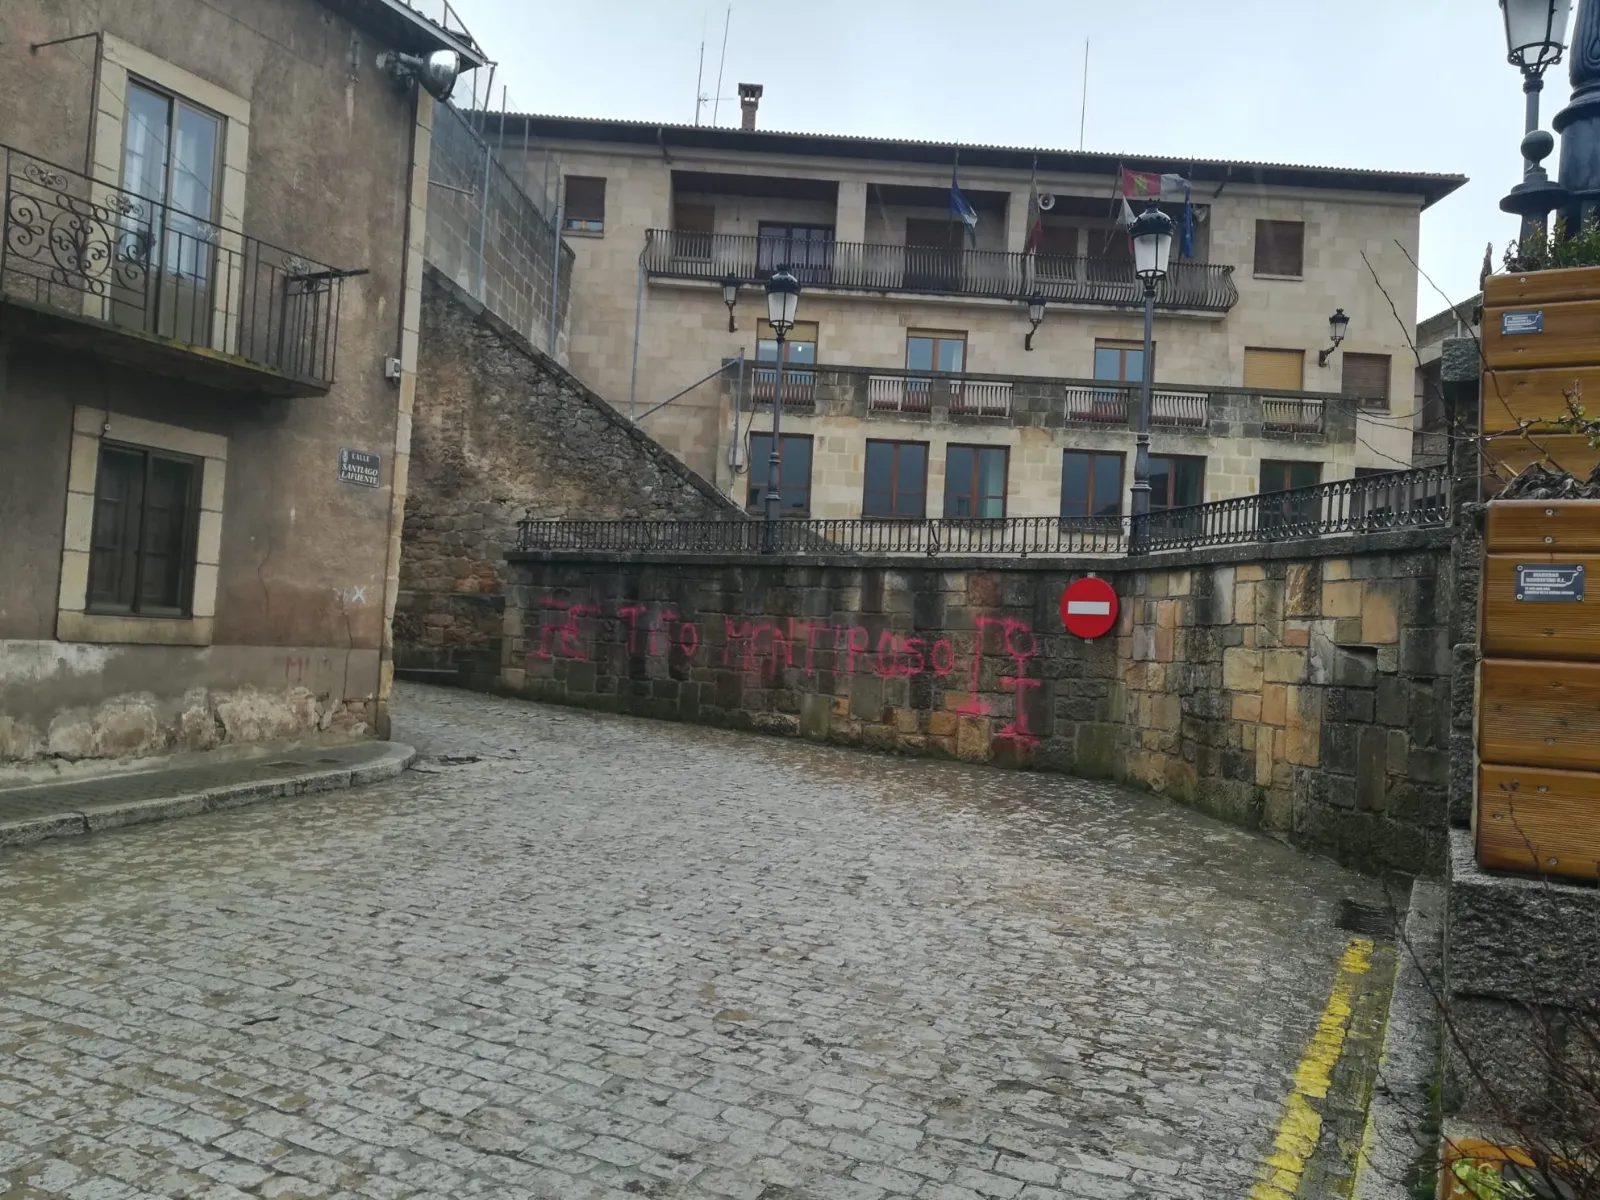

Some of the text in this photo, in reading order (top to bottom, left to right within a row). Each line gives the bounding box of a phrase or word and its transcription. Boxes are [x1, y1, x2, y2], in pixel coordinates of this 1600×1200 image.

[351, 453, 370, 462] CALLE
[341, 463, 378, 477] SANTIAGO
[341, 470, 377, 484] LAFUENTE
